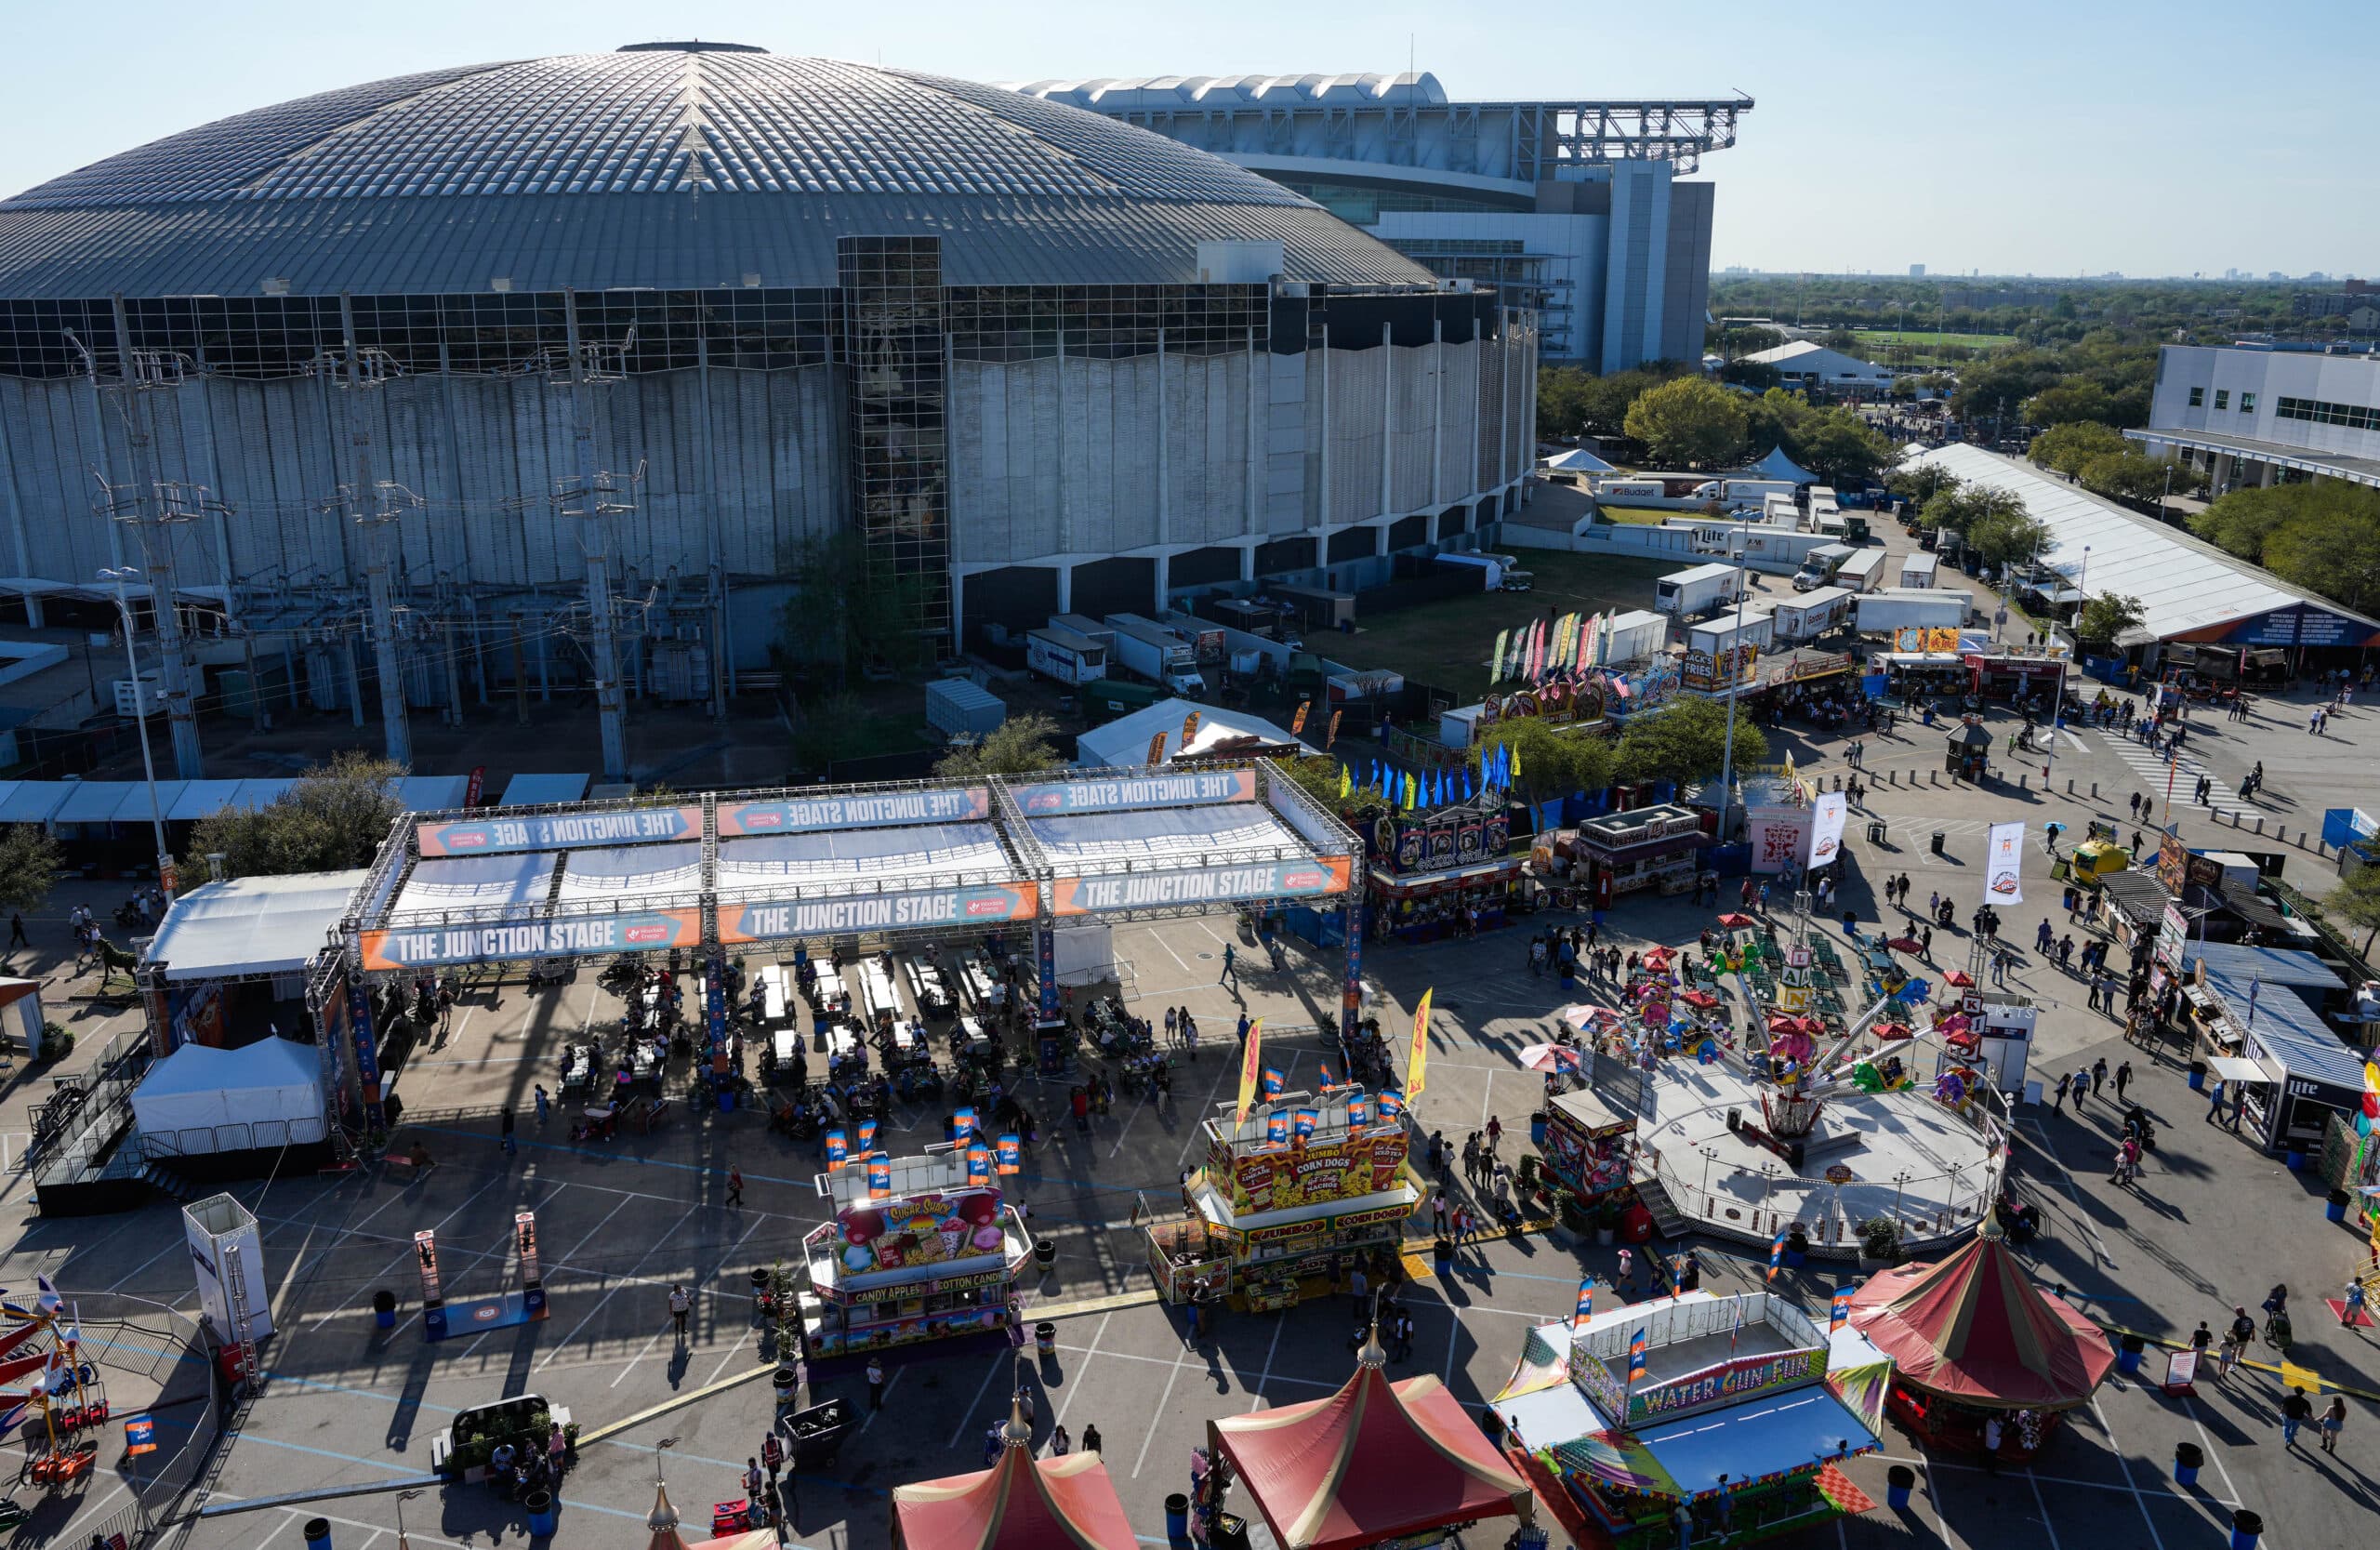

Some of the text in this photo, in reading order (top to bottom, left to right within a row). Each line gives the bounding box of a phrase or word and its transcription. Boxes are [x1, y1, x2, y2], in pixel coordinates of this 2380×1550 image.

[1623, 487, 1655, 497] Budget
[1701, 528, 1725, 544] Lite
[1686, 653, 1712, 665] JACK'S
[1685, 663, 1711, 677] FRIES
[1414, 848, 1493, 872] GREEK GRILL
[166, 877, 173, 887] 8
[1086, 868, 1276, 907] THE JUNCTION STAGE
[751, 894, 958, 934] THE JUNCTION STAGE
[396, 920, 615, 961] THE JUNCTION STAGE
[1784, 970, 1797, 983] A
[1790, 991, 1805, 1006] N
[1966, 1000, 1977, 1010] K
[2243, 1034, 2263, 1061] Lite
[2287, 1080, 2319, 1095] Lite
[1305, 1149, 1340, 1161] JUMBO
[1297, 1158, 1351, 1174] CORN DOGS
[1306, 1182, 1338, 1192] NACHOS
[890, 1198, 952, 1223] SUGAR SHACK
[1344, 1209, 1402, 1225] CORN DOGS
[218, 1225, 257, 1245] TICKETS
[1262, 1223, 1315, 1239] JUMBO
[938, 1272, 1002, 1290] COTTON CANDY
[855, 1286, 920, 1303] CANDY APPLES
[1643, 1355, 1809, 1414] WATER GUN FUN
